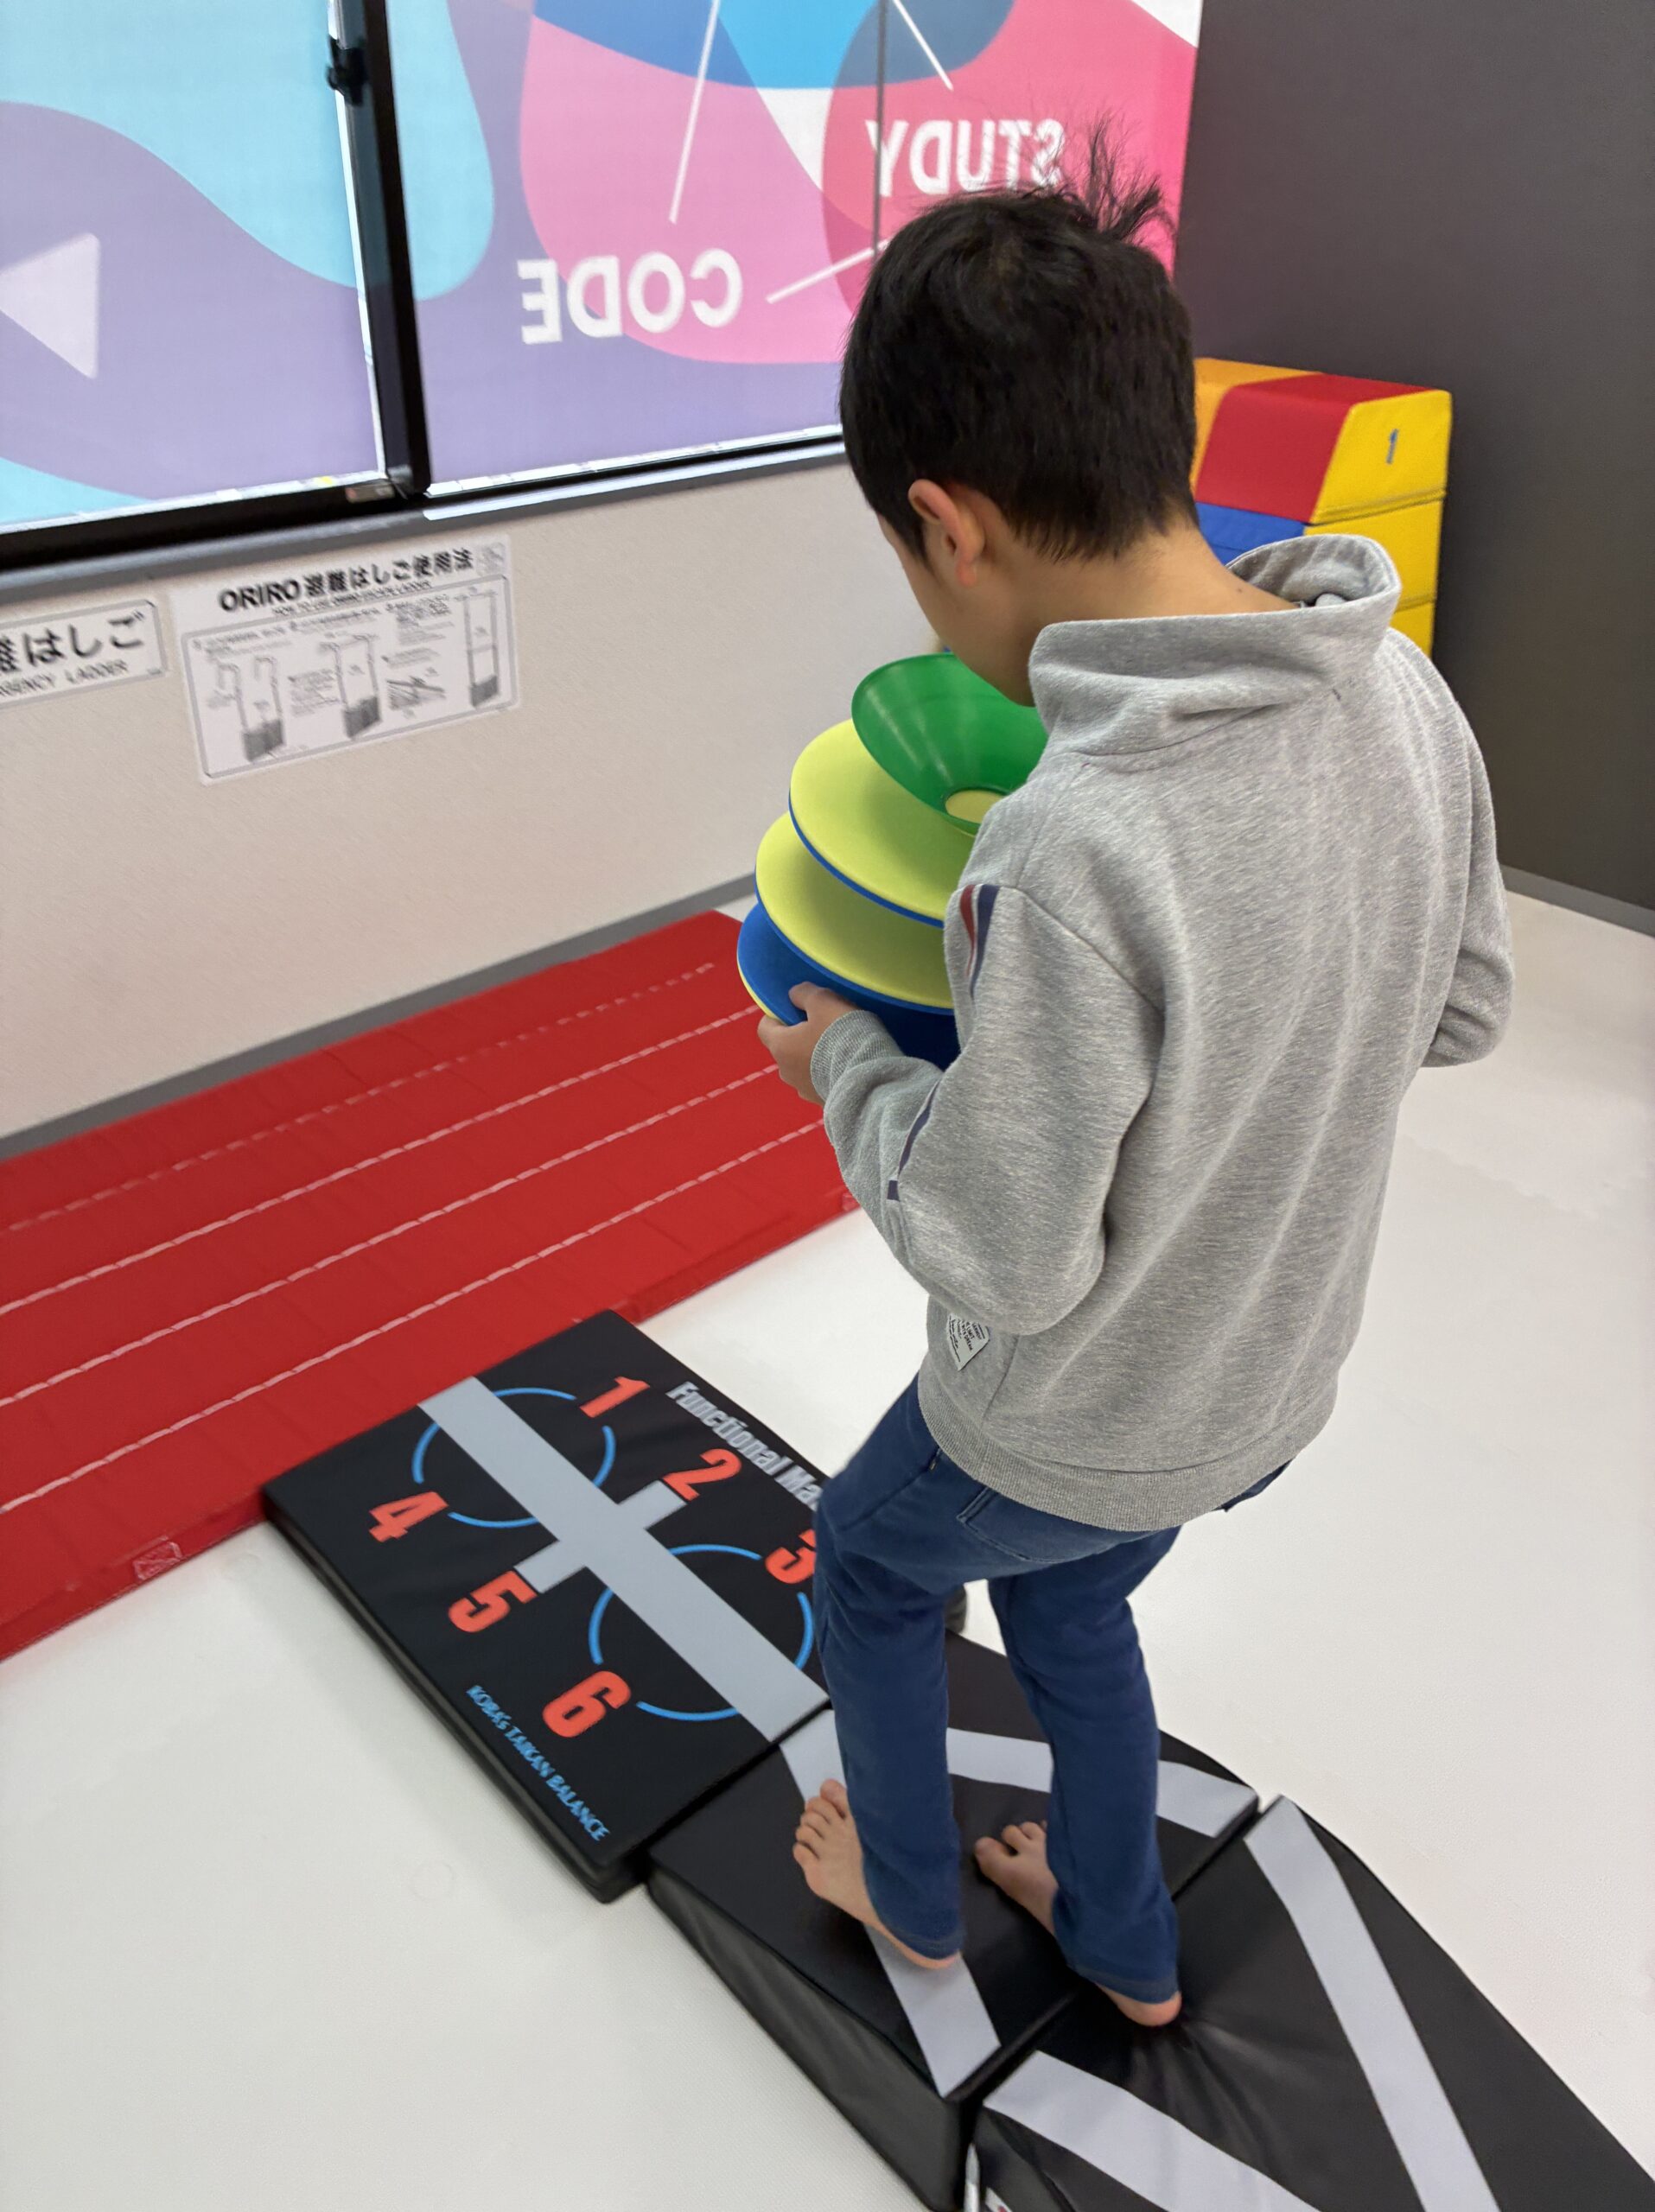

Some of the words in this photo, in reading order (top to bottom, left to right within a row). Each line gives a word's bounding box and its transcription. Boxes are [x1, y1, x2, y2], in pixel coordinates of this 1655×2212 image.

[581, 1376, 649, 1419] 1
[662, 1447, 742, 1501] 2
[665, 1381, 794, 1477] Functional
[774, 1465, 823, 1512] Ma
[369, 1491, 449, 1542] 4
[765, 1529, 817, 1584] 3
[449, 1570, 537, 1633] 5
[542, 1670, 632, 1738] 6
[546, 1775, 610, 1841] BALANCE
